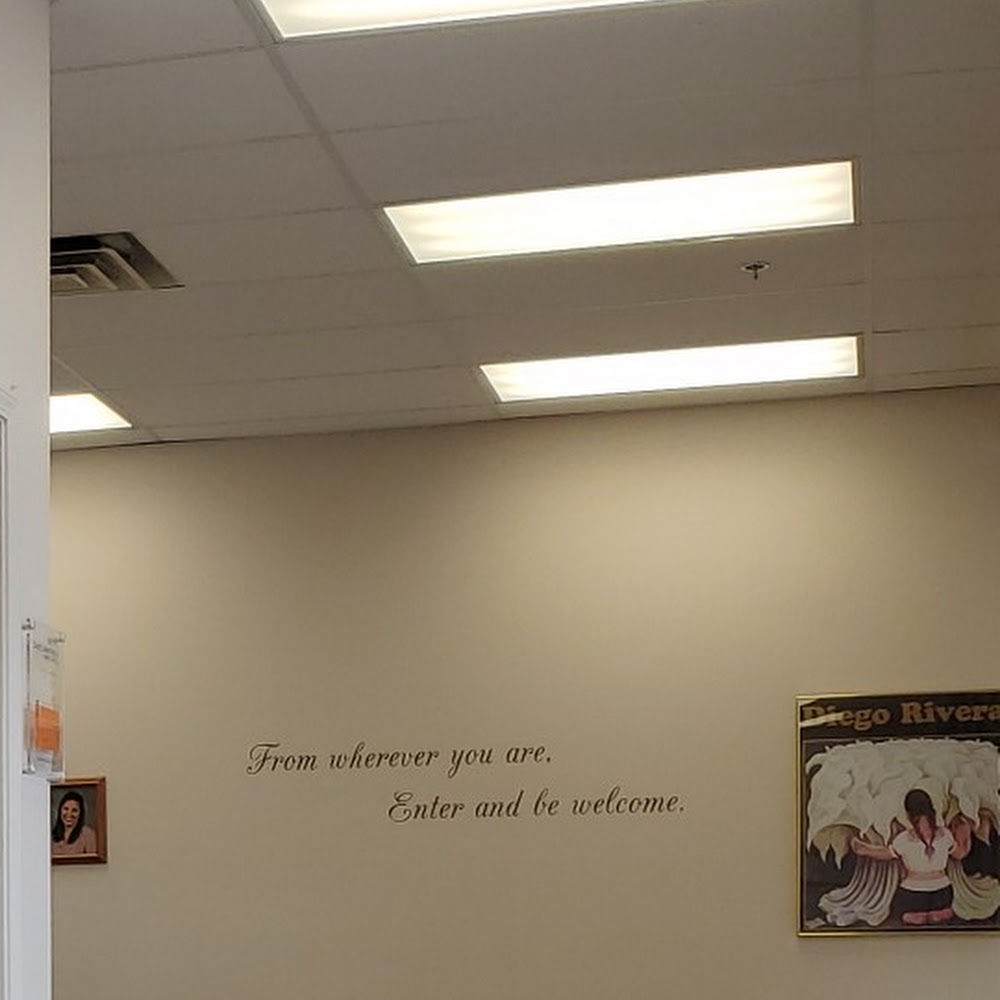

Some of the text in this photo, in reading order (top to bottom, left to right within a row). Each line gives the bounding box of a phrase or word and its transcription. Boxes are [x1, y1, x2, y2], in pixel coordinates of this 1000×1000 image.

[900, 701, 1000, 724] Rivera
[246, 743, 317, 775] From
[329, 741, 440, 769] wherever
[447, 748, 493, 778] you
[388, 786, 685, 823] Enter and be welcome.
